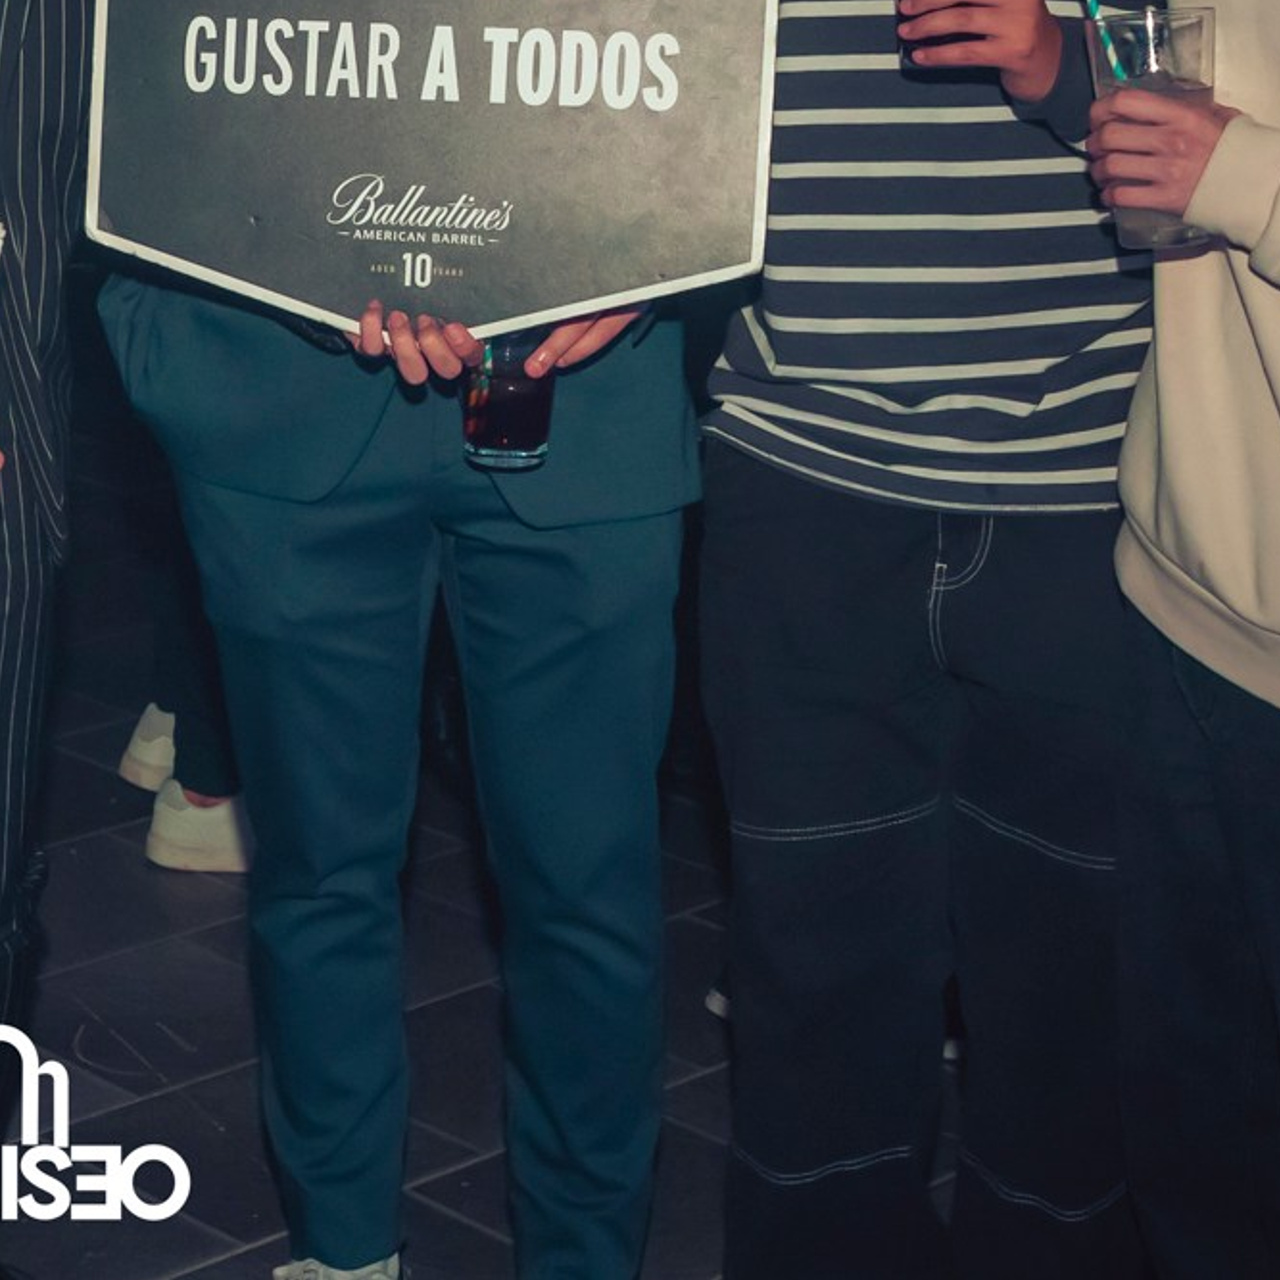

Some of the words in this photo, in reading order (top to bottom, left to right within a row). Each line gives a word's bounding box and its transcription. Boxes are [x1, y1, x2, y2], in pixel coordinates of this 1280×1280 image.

[184, 16, 400, 100] GUSTAR
[421, 25, 460, 102] A
[484, 27, 682, 113] TODOS
[326, 173, 514, 231] Ballantine's
[353, 229, 426, 243] AMERICAN
[431, 233, 485, 246] BARREL
[402, 252, 433, 288] 10
